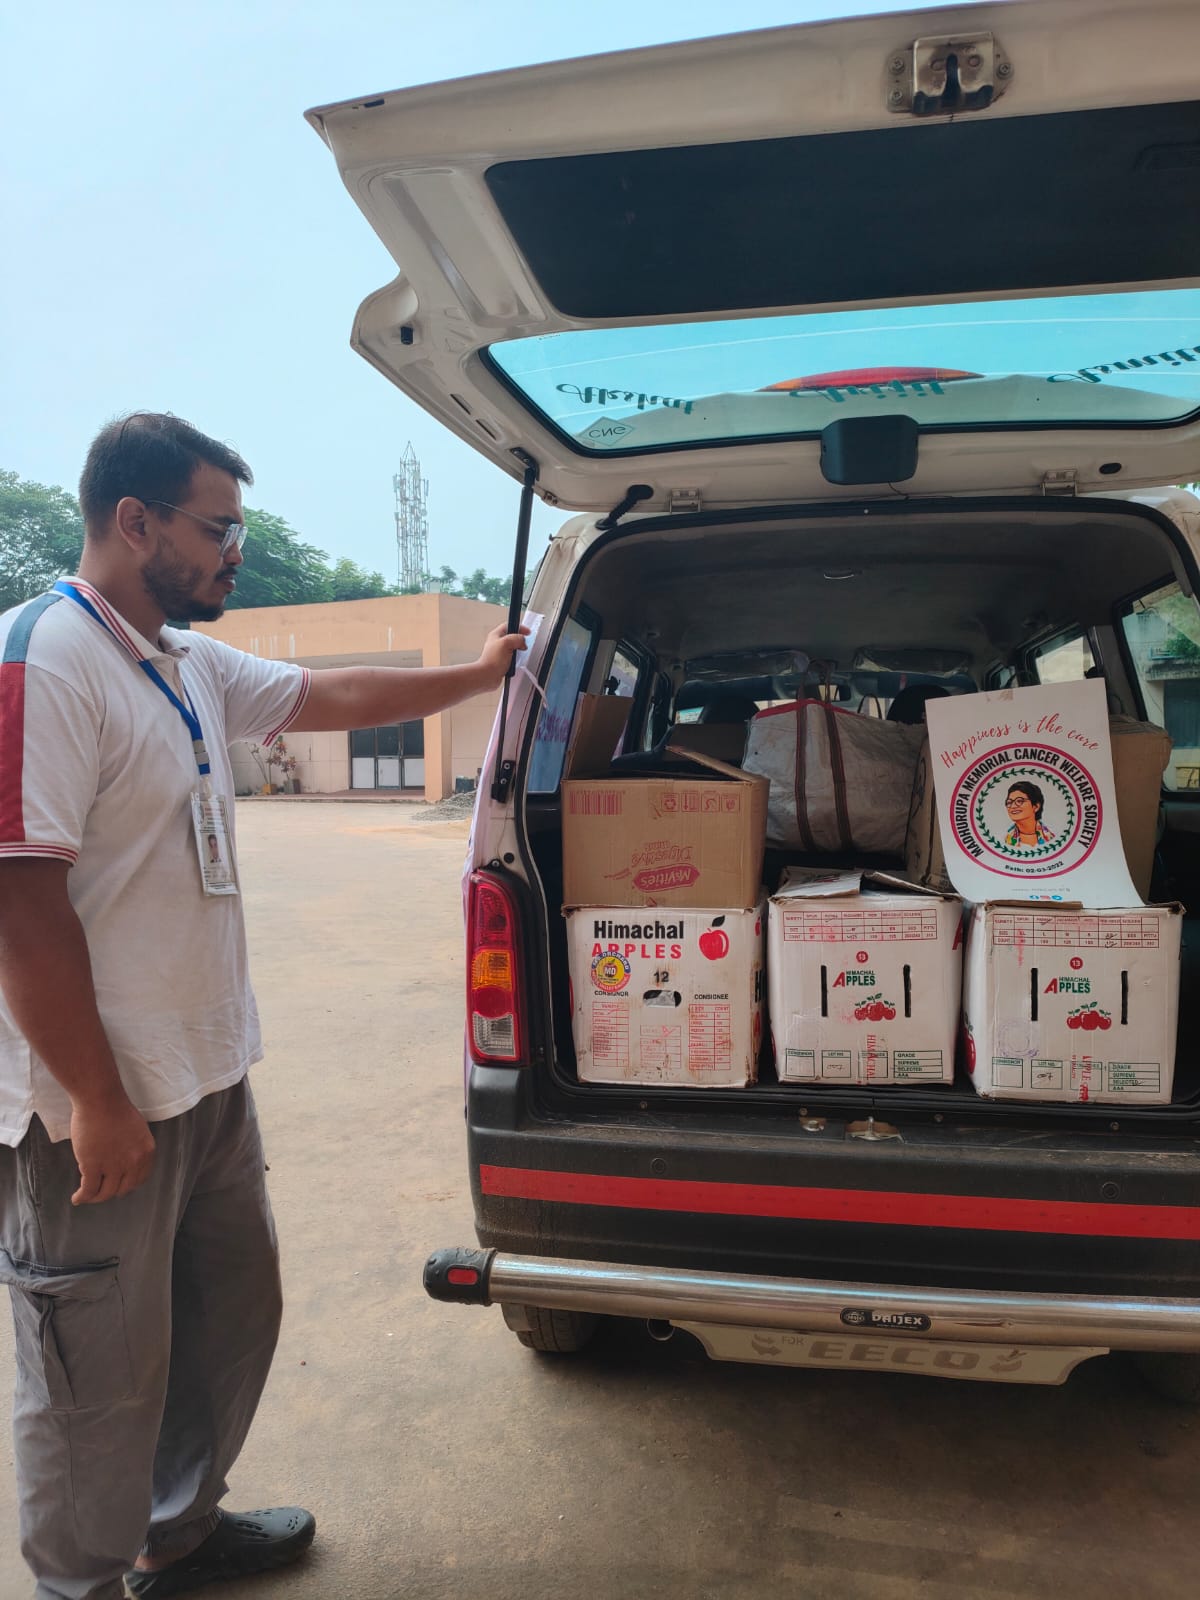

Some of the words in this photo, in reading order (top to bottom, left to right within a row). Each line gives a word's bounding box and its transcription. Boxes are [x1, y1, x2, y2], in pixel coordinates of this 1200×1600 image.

[940, 721, 1011, 768] Happiness
[1018, 719, 1031, 733] is
[1036, 712, 1064, 734] the
[1067, 729, 1100, 751] cure
[1014, 748, 1060, 766] CANCER
[963, 752, 1012, 792] MEMORIAL
[1059, 759, 1094, 803] WELFARE
[955, 793, 984, 858] MADHURUPA
[1078, 803, 1098, 848] SOCIETY
[593, 920, 685, 939] Himachal
[591, 942, 682, 959] APPLES
[653, 971, 670, 983] 12
[832, 972, 876, 987] APPLES
[1044, 978, 1091, 994] APPLES
[808, 1340, 981, 1370] EECO
